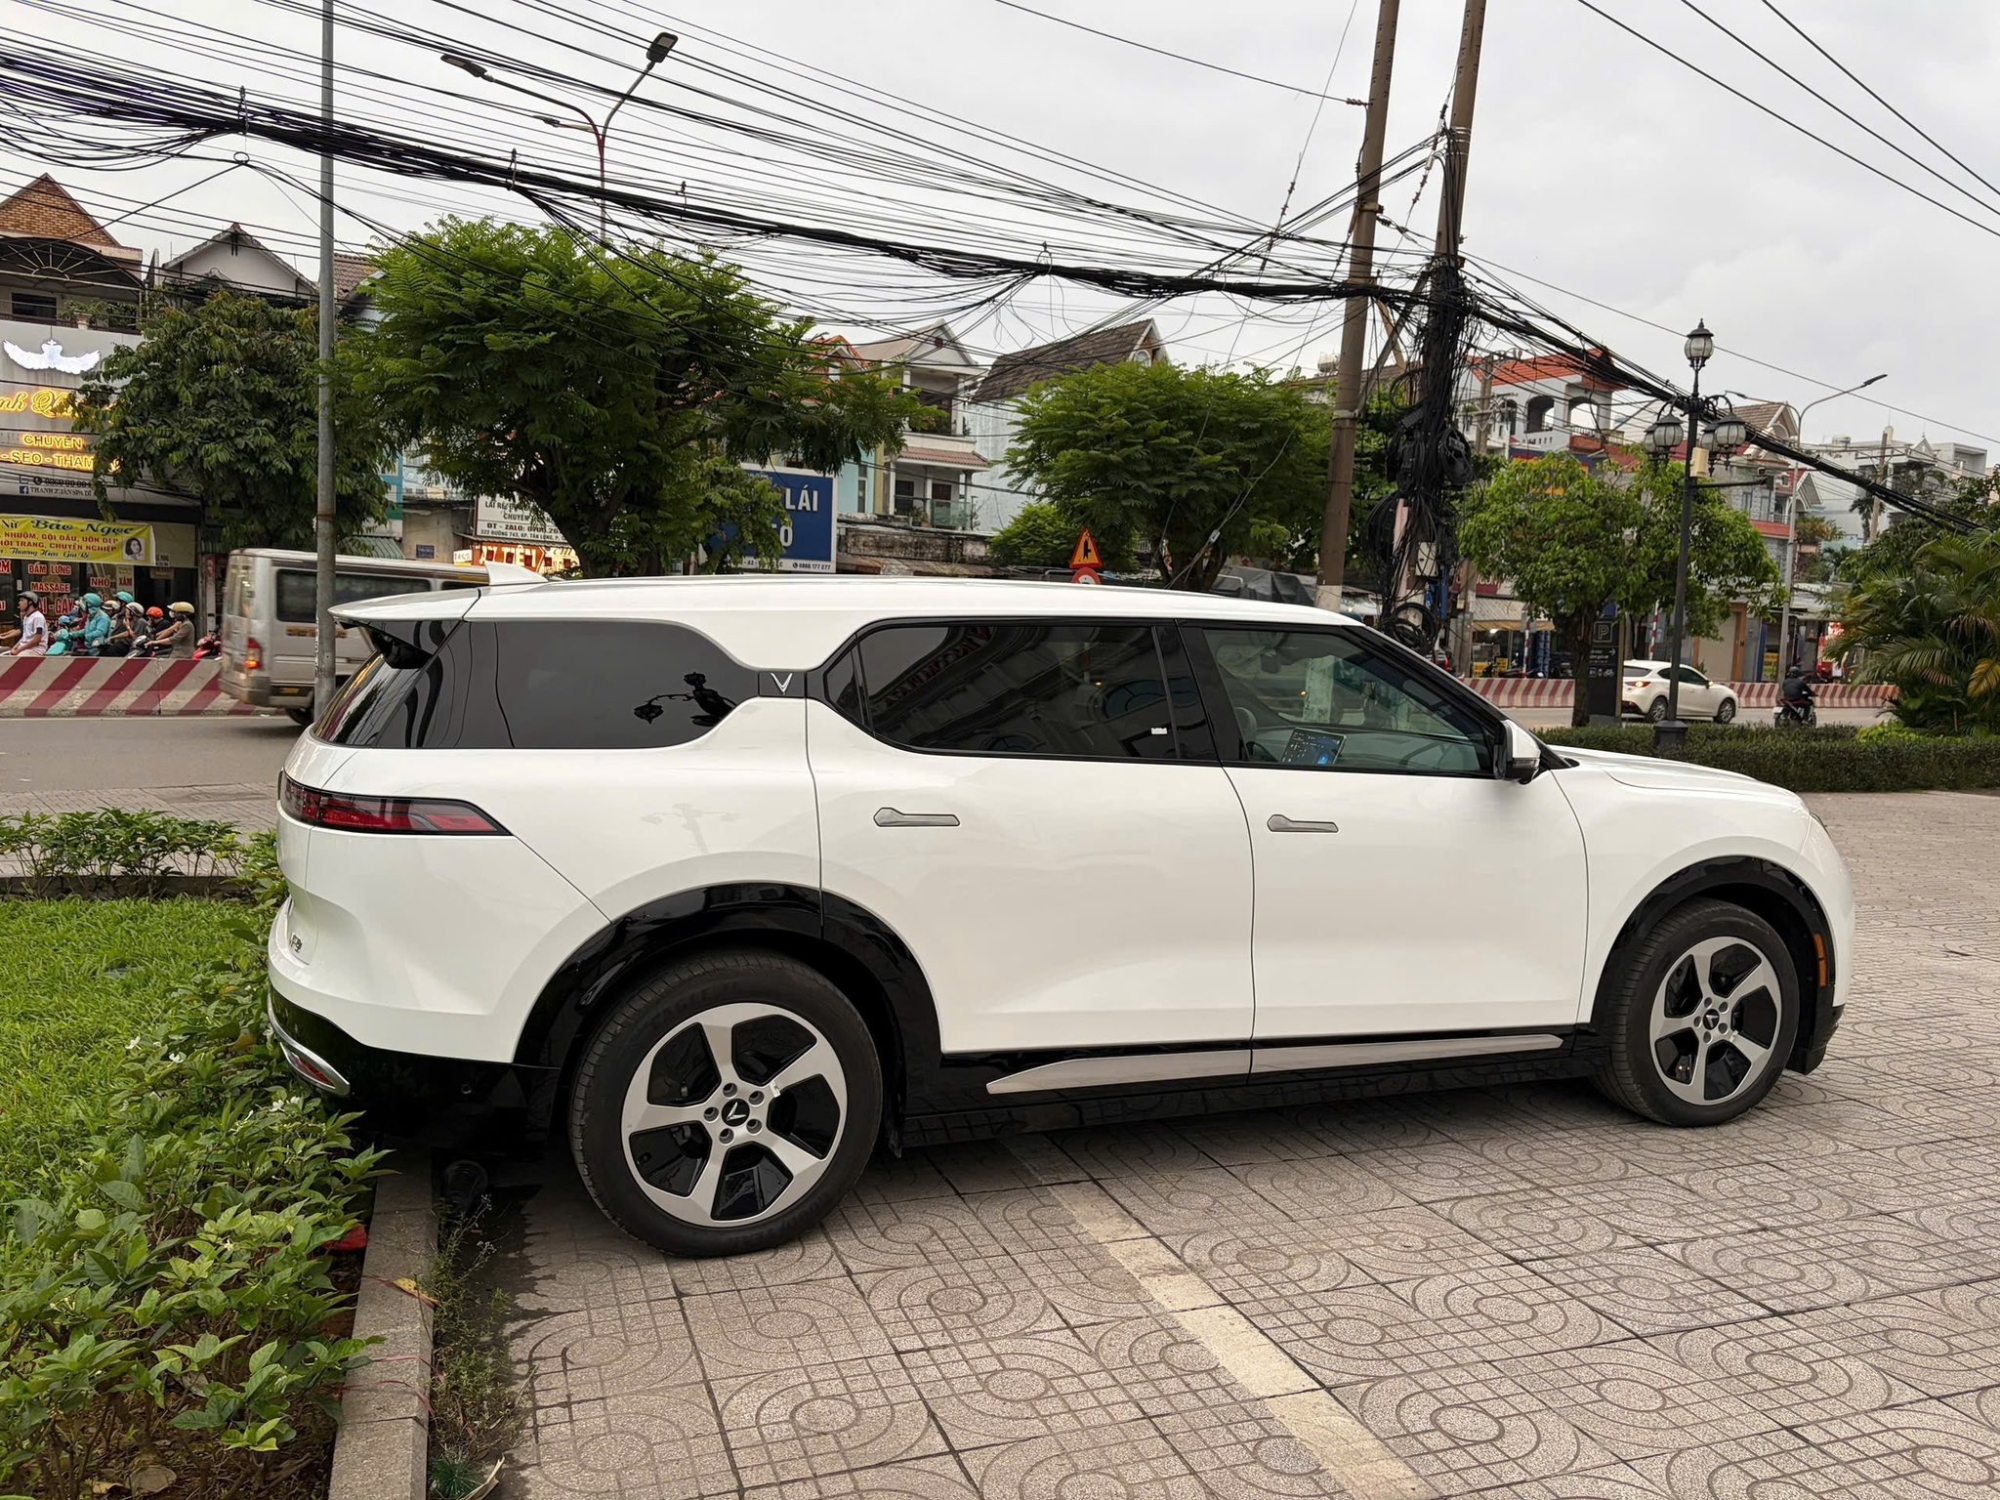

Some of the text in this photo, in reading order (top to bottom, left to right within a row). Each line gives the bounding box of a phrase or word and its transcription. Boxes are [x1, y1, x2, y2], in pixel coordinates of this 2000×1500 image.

[23, 434, 83, 450] CHUYÊN
[784, 484, 819, 511] LÁI
[31, 581, 71, 593] MASSAGE
